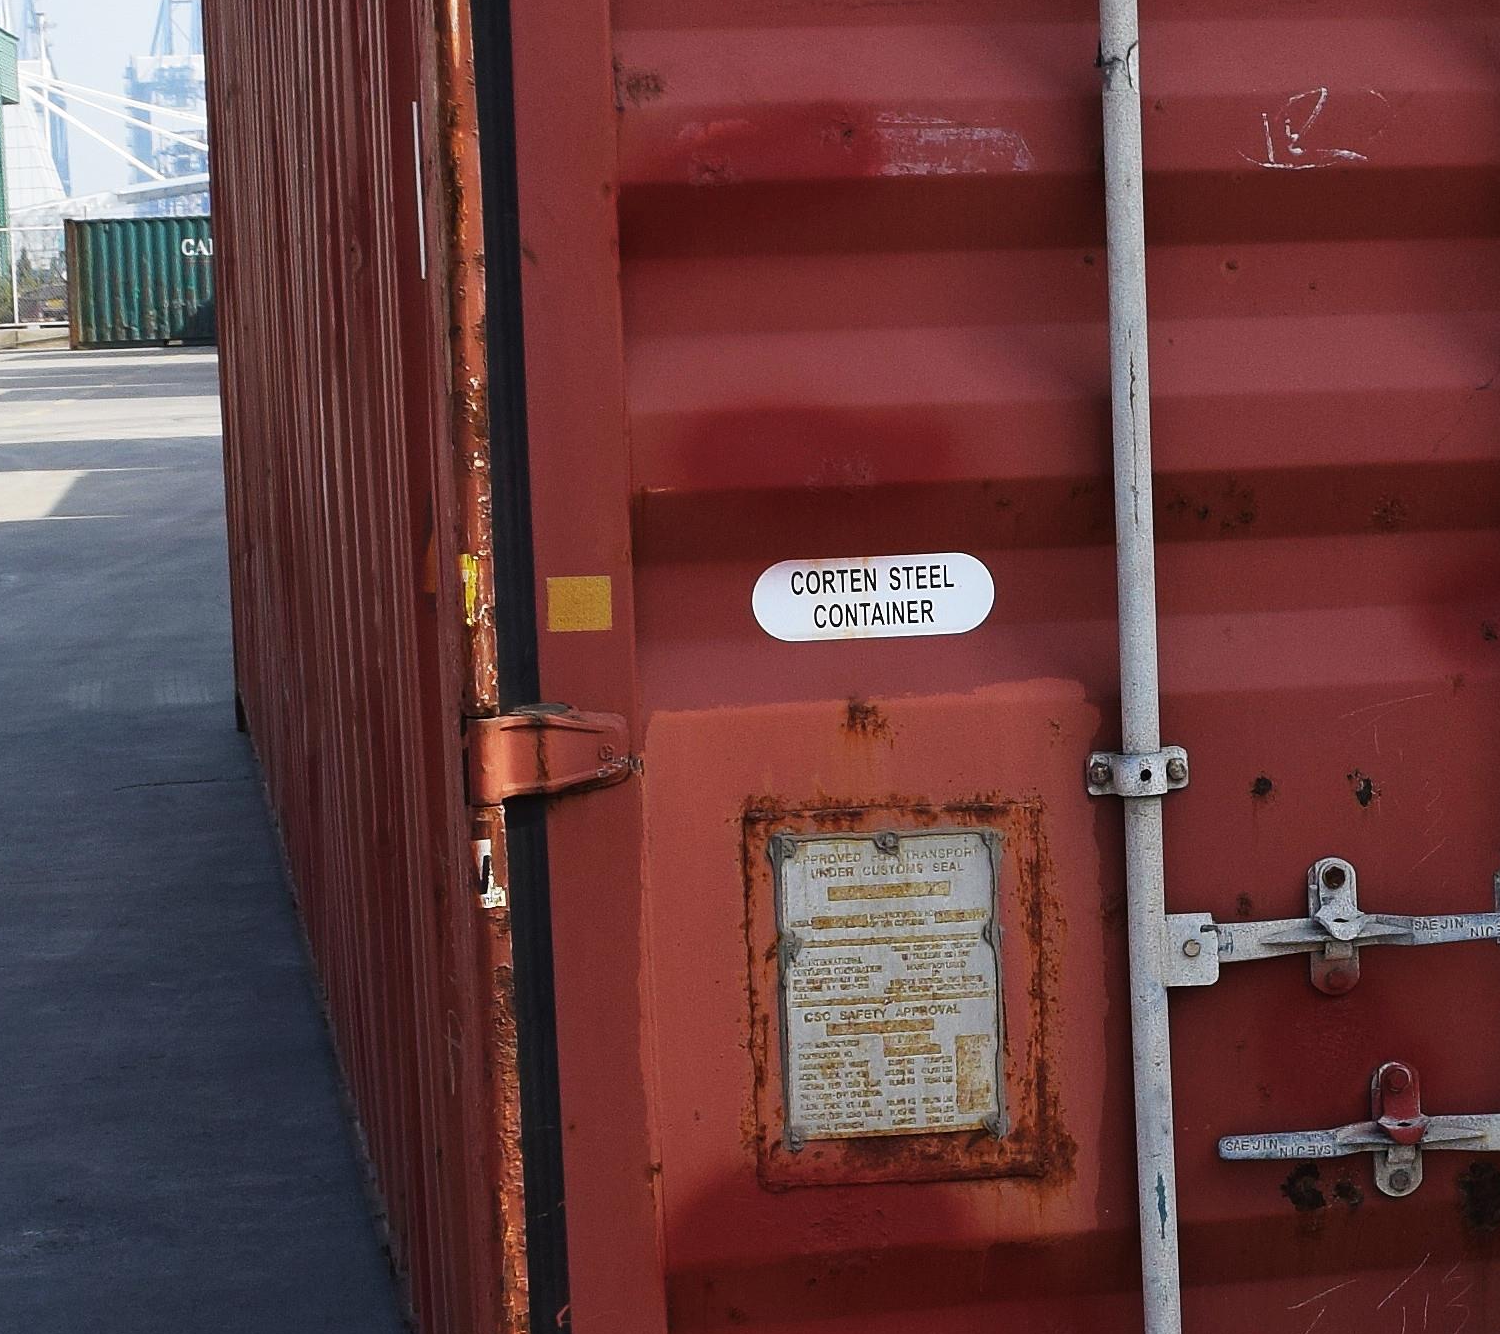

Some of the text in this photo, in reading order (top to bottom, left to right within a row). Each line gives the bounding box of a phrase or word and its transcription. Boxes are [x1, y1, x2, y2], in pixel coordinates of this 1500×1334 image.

[790, 563, 955, 596] CORTEN STEEL
[813, 598, 935, 630] CONTAINER
[932, 860, 965, 873] SEAL
[1414, 918, 1464, 931] SAEJIN
[839, 1007, 887, 1021] SAFETY
[895, 1004, 962, 1018] APPROVAL
[1225, 1138, 1278, 1152] SAEJIN
